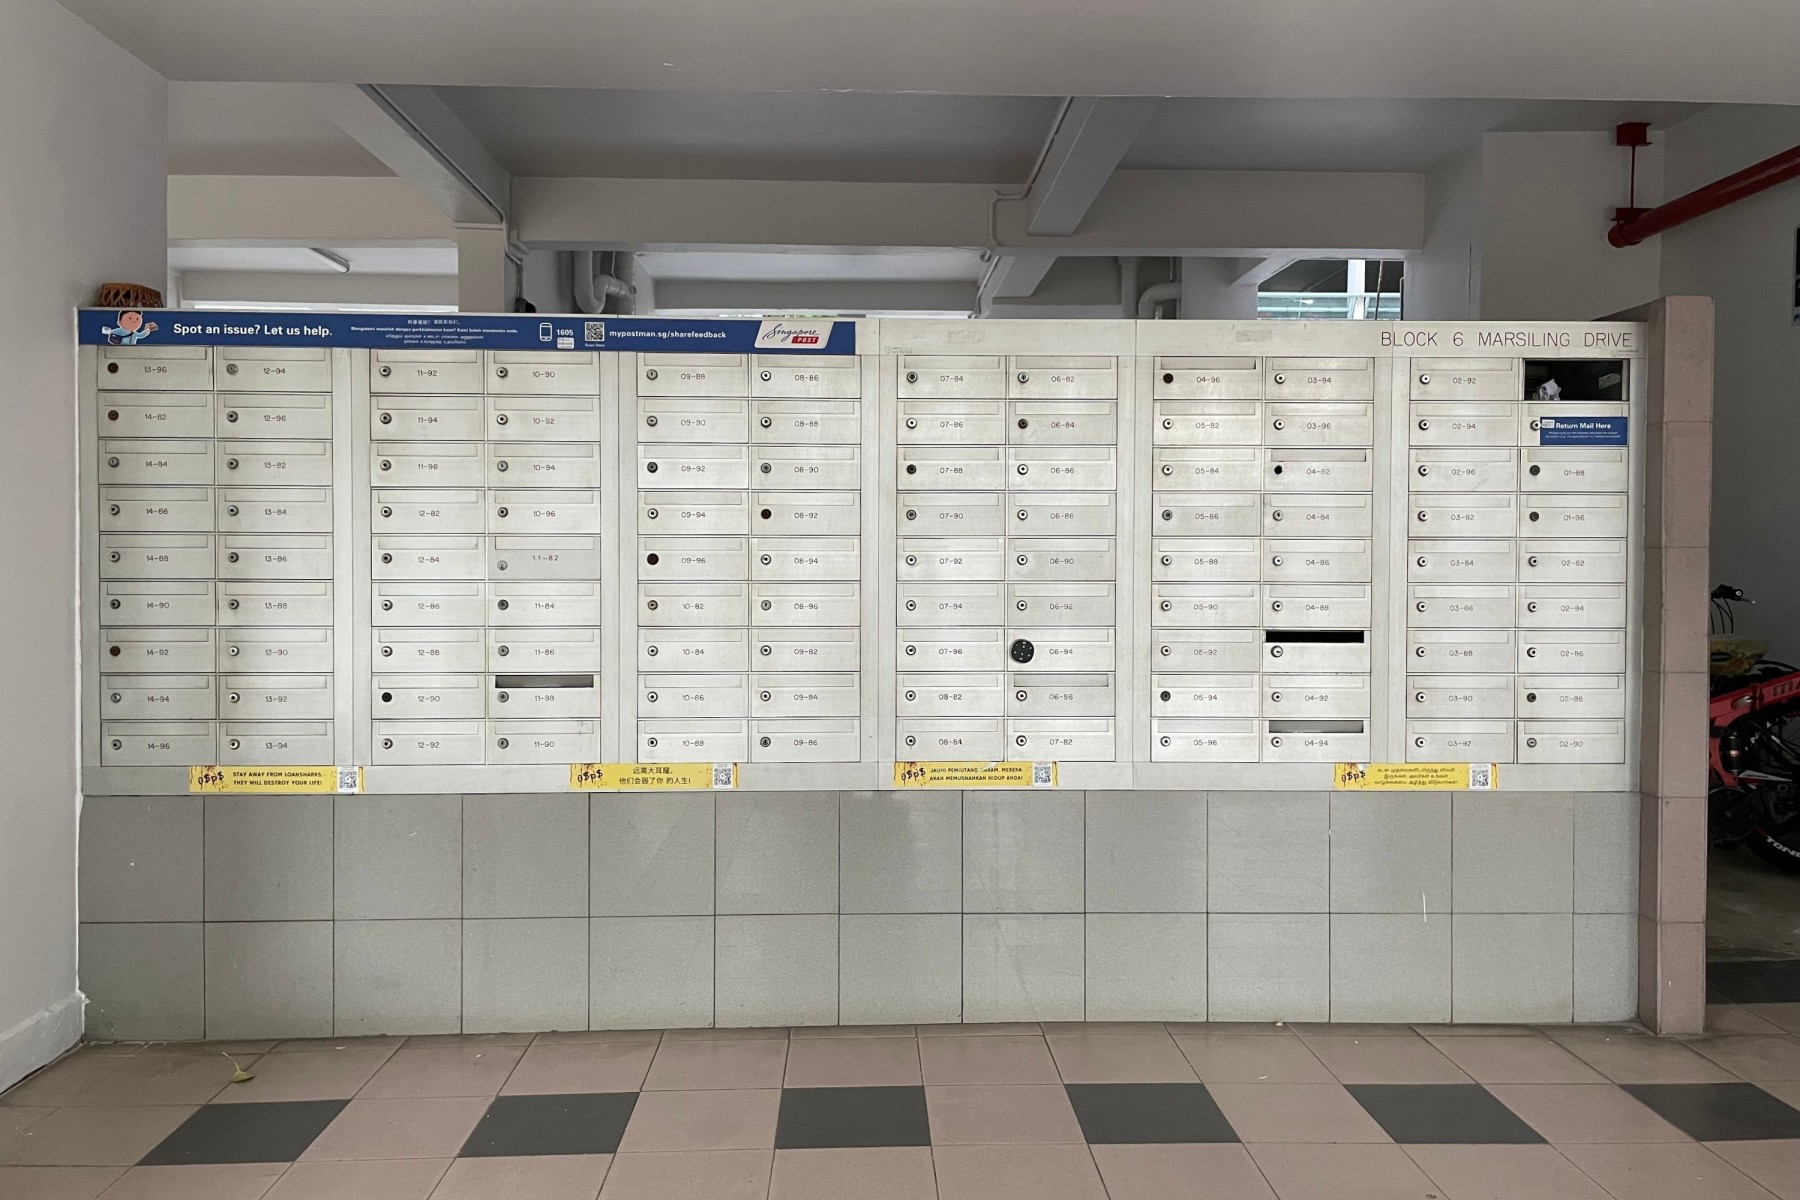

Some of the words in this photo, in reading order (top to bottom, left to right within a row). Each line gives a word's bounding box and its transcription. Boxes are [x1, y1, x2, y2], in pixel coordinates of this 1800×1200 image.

[173, 323, 203, 336] Spot
[205, 325, 220, 334] an
[223, 323, 261, 335] issue?
[263, 324, 283, 335] Let
[286, 326, 301, 336] us
[303, 325, 333, 338] help.
[556, 328, 574, 336] 1605
[609, 329, 727, 340] mypostman.sg/sharefeedback
[761, 323, 821, 343] Singapore
[1381, 331, 1438, 347] BLOCK
[1452, 332, 1464, 347] 6
[1478, 331, 1571, 348] MARSILING
[1583, 332, 1633, 348] DRIVE
[144, 365, 168, 374] 13-96
[263, 367, 286, 375] 12-94
[417, 369, 438, 377] 11-92
[532, 370, 556, 378] 10-90
[794, 374, 819, 382] 08-86
[939, 375, 964, 383] 07-84
[1050, 375, 1075, 383] 06-82
[1196, 376, 1221, 384] 04-96
[1307, 376, 1332, 384] 03-94
[1452, 377, 1477, 385] 02-92
[144, 413, 167, 421] 14-82
[263, 414, 287, 422] 12-96
[417, 416, 438, 424] 11-94
[532, 417, 555, 425] 10-92
[680, 419, 706, 427] 09-90
[794, 420, 819, 428] 08-88
[1050, 421, 1075, 429] 06-84
[1306, 422, 1332, 430] 03-96
[1451, 422, 1476, 430] 02-94
[145, 460, 168, 468] 14-84
[263, 461, 287, 469] 13-82
[417, 463, 439, 471] 11-96
[680, 465, 706, 473] 09-92
[793, 466, 819, 474] 08-90
[1195, 467, 1220, 475] 05-84
[1306, 468, 1331, 476] 04-82
[1451, 468, 1476, 476] 02-96
[145, 507, 169, 515] 14-86
[264, 508, 287, 516] 13-84
[418, 509, 441, 517] 12-82
[533, 510, 556, 518] 10-96
[680, 511, 706, 519] 09-94
[793, 511, 819, 519] 08-92
[939, 512, 964, 520] 07-90
[1050, 512, 1074, 520] 06-88
[1194, 512, 1219, 520] 05-86
[1305, 513, 1330, 521] 04-84
[1563, 514, 1585, 522] 01-96
[146, 554, 169, 562] 14-88
[264, 555, 288, 563] 13-86
[417, 556, 440, 564] 12-84
[532, 554, 559, 562] 11-82
[793, 557, 819, 565] 08-94
[939, 557, 963, 565] 07-92
[1049, 557, 1075, 565] 06-90
[1194, 558, 1219, 566] 05-88
[1449, 559, 1474, 567] 03-84
[1561, 559, 1585, 567] 02-82
[146, 601, 170, 609] 14-90
[264, 602, 288, 610] 13-88
[417, 602, 441, 610] 12-86
[534, 602, 555, 610] 11-84
[682, 602, 705, 610] 10-82
[793, 602, 819, 610] 08-96
[938, 602, 963, 610] 07-94
[1049, 603, 1073, 611] 06-92
[1193, 603, 1219, 611] 05-90
[1449, 603, 1474, 612] 03-86
[1560, 604, 1585, 612] 02-84
[146, 648, 169, 656] 14-92
[265, 648, 289, 656] 13-90
[534, 648, 555, 656] 11-86
[682, 648, 705, 656] 10-84
[793, 648, 818, 656] 09-82
[1193, 648, 1218, 656] 05-92
[1448, 649, 1473, 657] 03-88
[1559, 650, 1584, 658] 02-86
[147, 695, 170, 703] 14-94
[265, 695, 288, 703] 13-92
[417, 695, 441, 703] 12-90
[682, 694, 705, 702] 10-86
[793, 693, 818, 701] 09-84
[938, 693, 963, 701] 08-82
[1048, 693, 1074, 701] 06-96
[1193, 694, 1218, 702] 05-94
[1304, 694, 1329, 702] 04-92
[1559, 695, 1584, 703] 02-88
[147, 742, 171, 750] 14-96
[265, 742, 288, 750] 13-94
[417, 741, 440, 749] 12-92
[534, 740, 555, 748] 11-90
[682, 739, 705, 747] 10-88
[793, 739, 818, 747] 09-86
[938, 738, 963, 746] 08-84
[1049, 738, 1073, 746] 07-82
[1304, 739, 1329, 747] 04-94
[1558, 740, 1584, 748] 02-90
